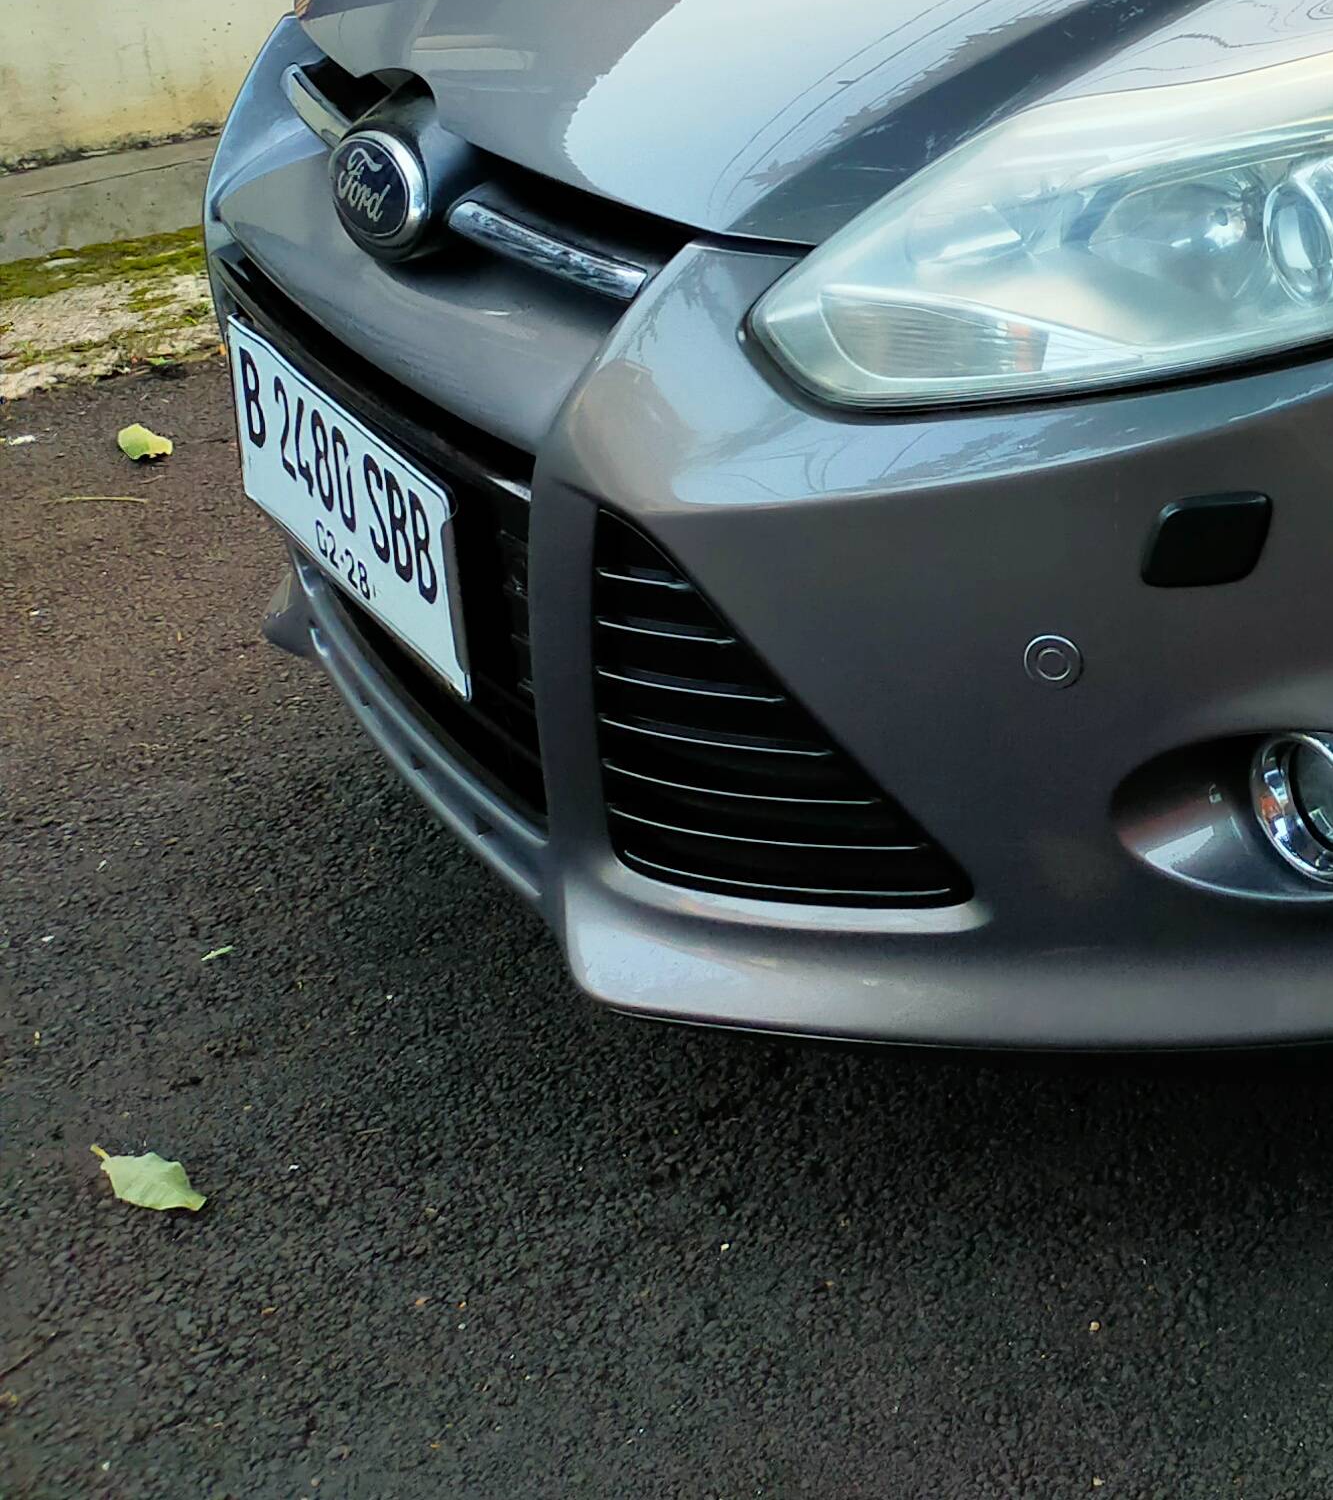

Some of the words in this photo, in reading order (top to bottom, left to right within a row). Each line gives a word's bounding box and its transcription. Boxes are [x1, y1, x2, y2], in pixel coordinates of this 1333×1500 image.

[338, 147, 391, 222] Ford
[239, 346, 266, 449] B
[274, 376, 357, 534] 2480
[363, 453, 438, 605] SBB
